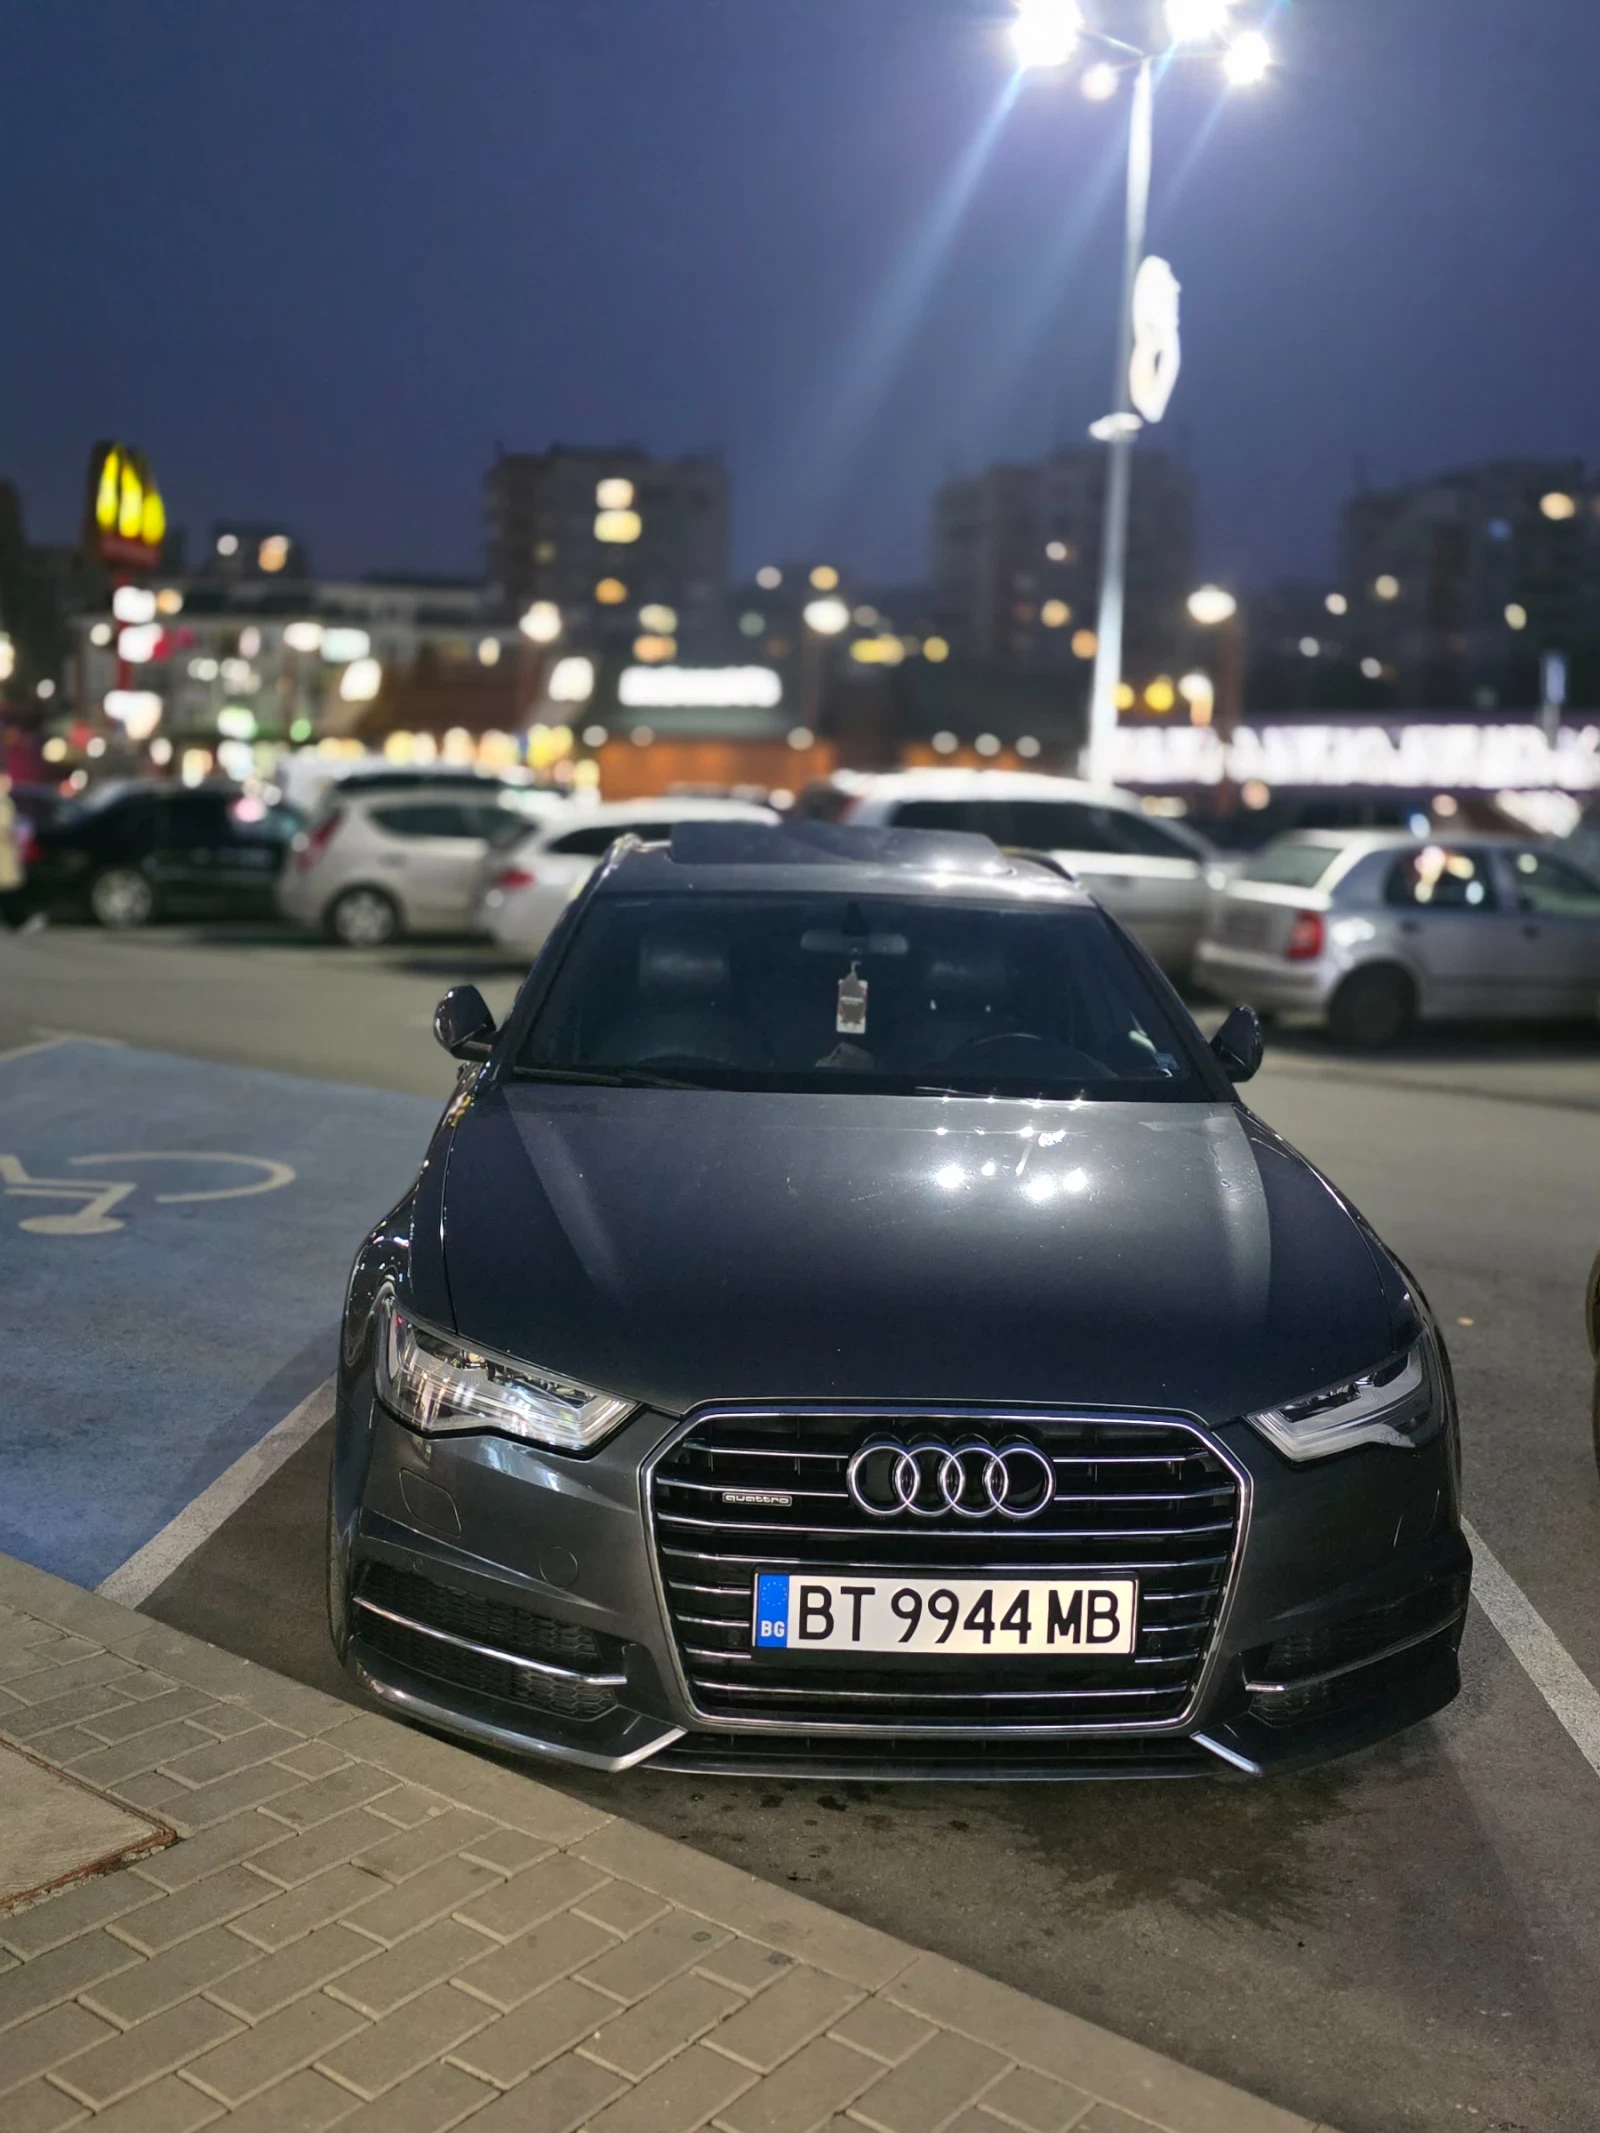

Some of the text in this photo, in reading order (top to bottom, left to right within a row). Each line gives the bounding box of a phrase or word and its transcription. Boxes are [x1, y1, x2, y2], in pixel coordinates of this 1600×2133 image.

[725, 1494, 790, 1505] quattro
[798, 1585, 1120, 1644] BT 9944 MB
[761, 1620, 785, 1638] BG
